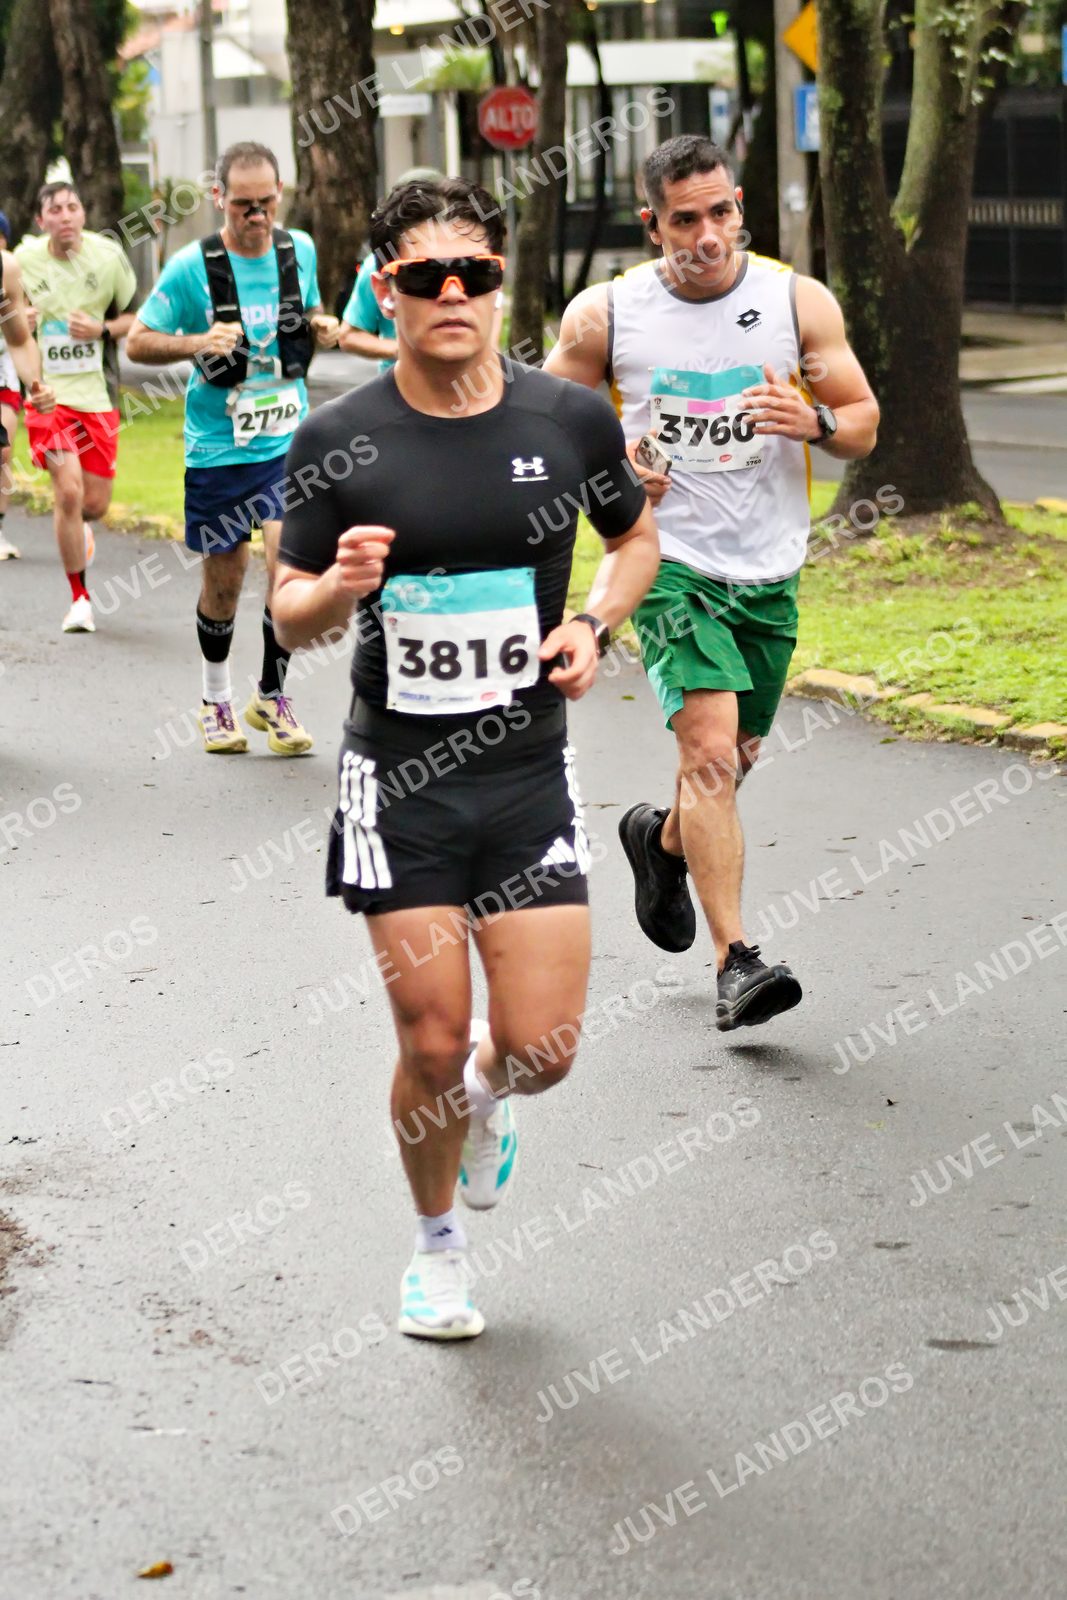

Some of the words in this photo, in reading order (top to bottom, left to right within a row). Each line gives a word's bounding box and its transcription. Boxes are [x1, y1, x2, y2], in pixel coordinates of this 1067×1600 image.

[485, 105, 536, 132] ALTO
[48, 343, 95, 361] 6663
[658, 412, 756, 447] 3760
[398, 634, 529, 681] 3816
